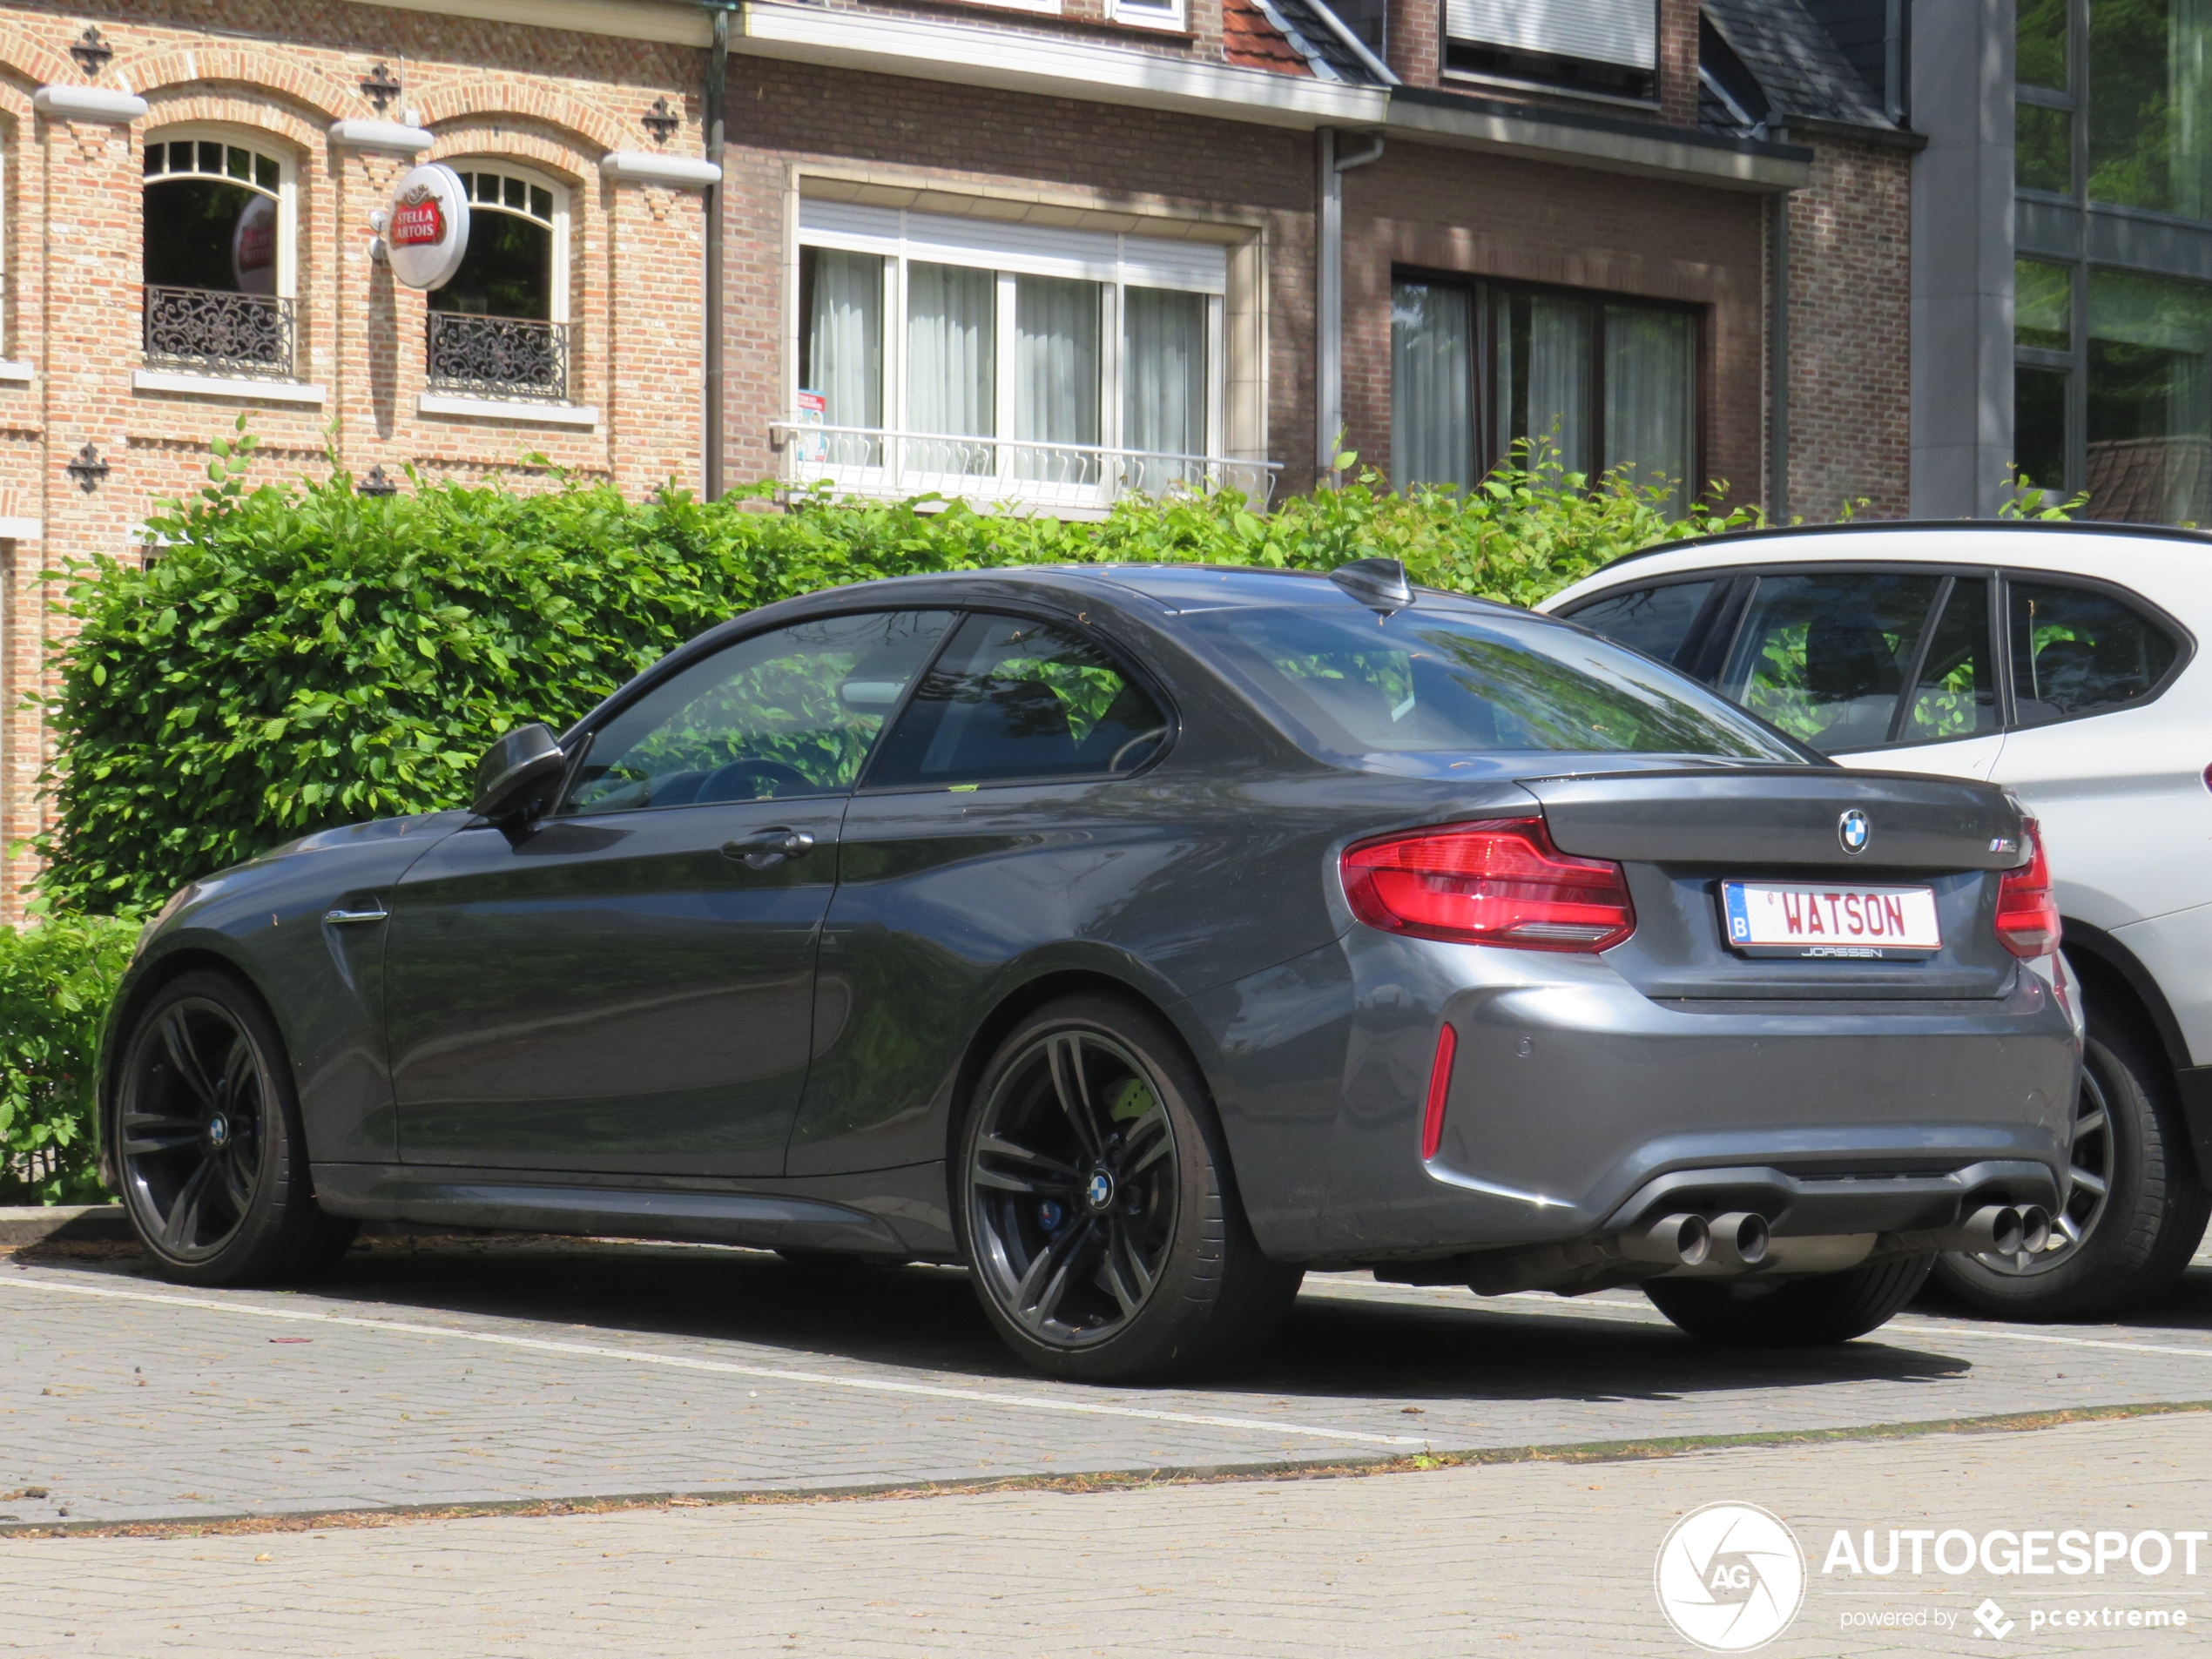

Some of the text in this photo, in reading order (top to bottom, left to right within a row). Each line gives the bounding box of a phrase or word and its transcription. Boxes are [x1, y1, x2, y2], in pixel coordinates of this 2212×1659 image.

[397, 210, 434, 225] STELLA
[397, 224, 434, 239] ARTOIS
[1782, 892, 1905, 936] WATSON
[1733, 919, 1747, 938] B
